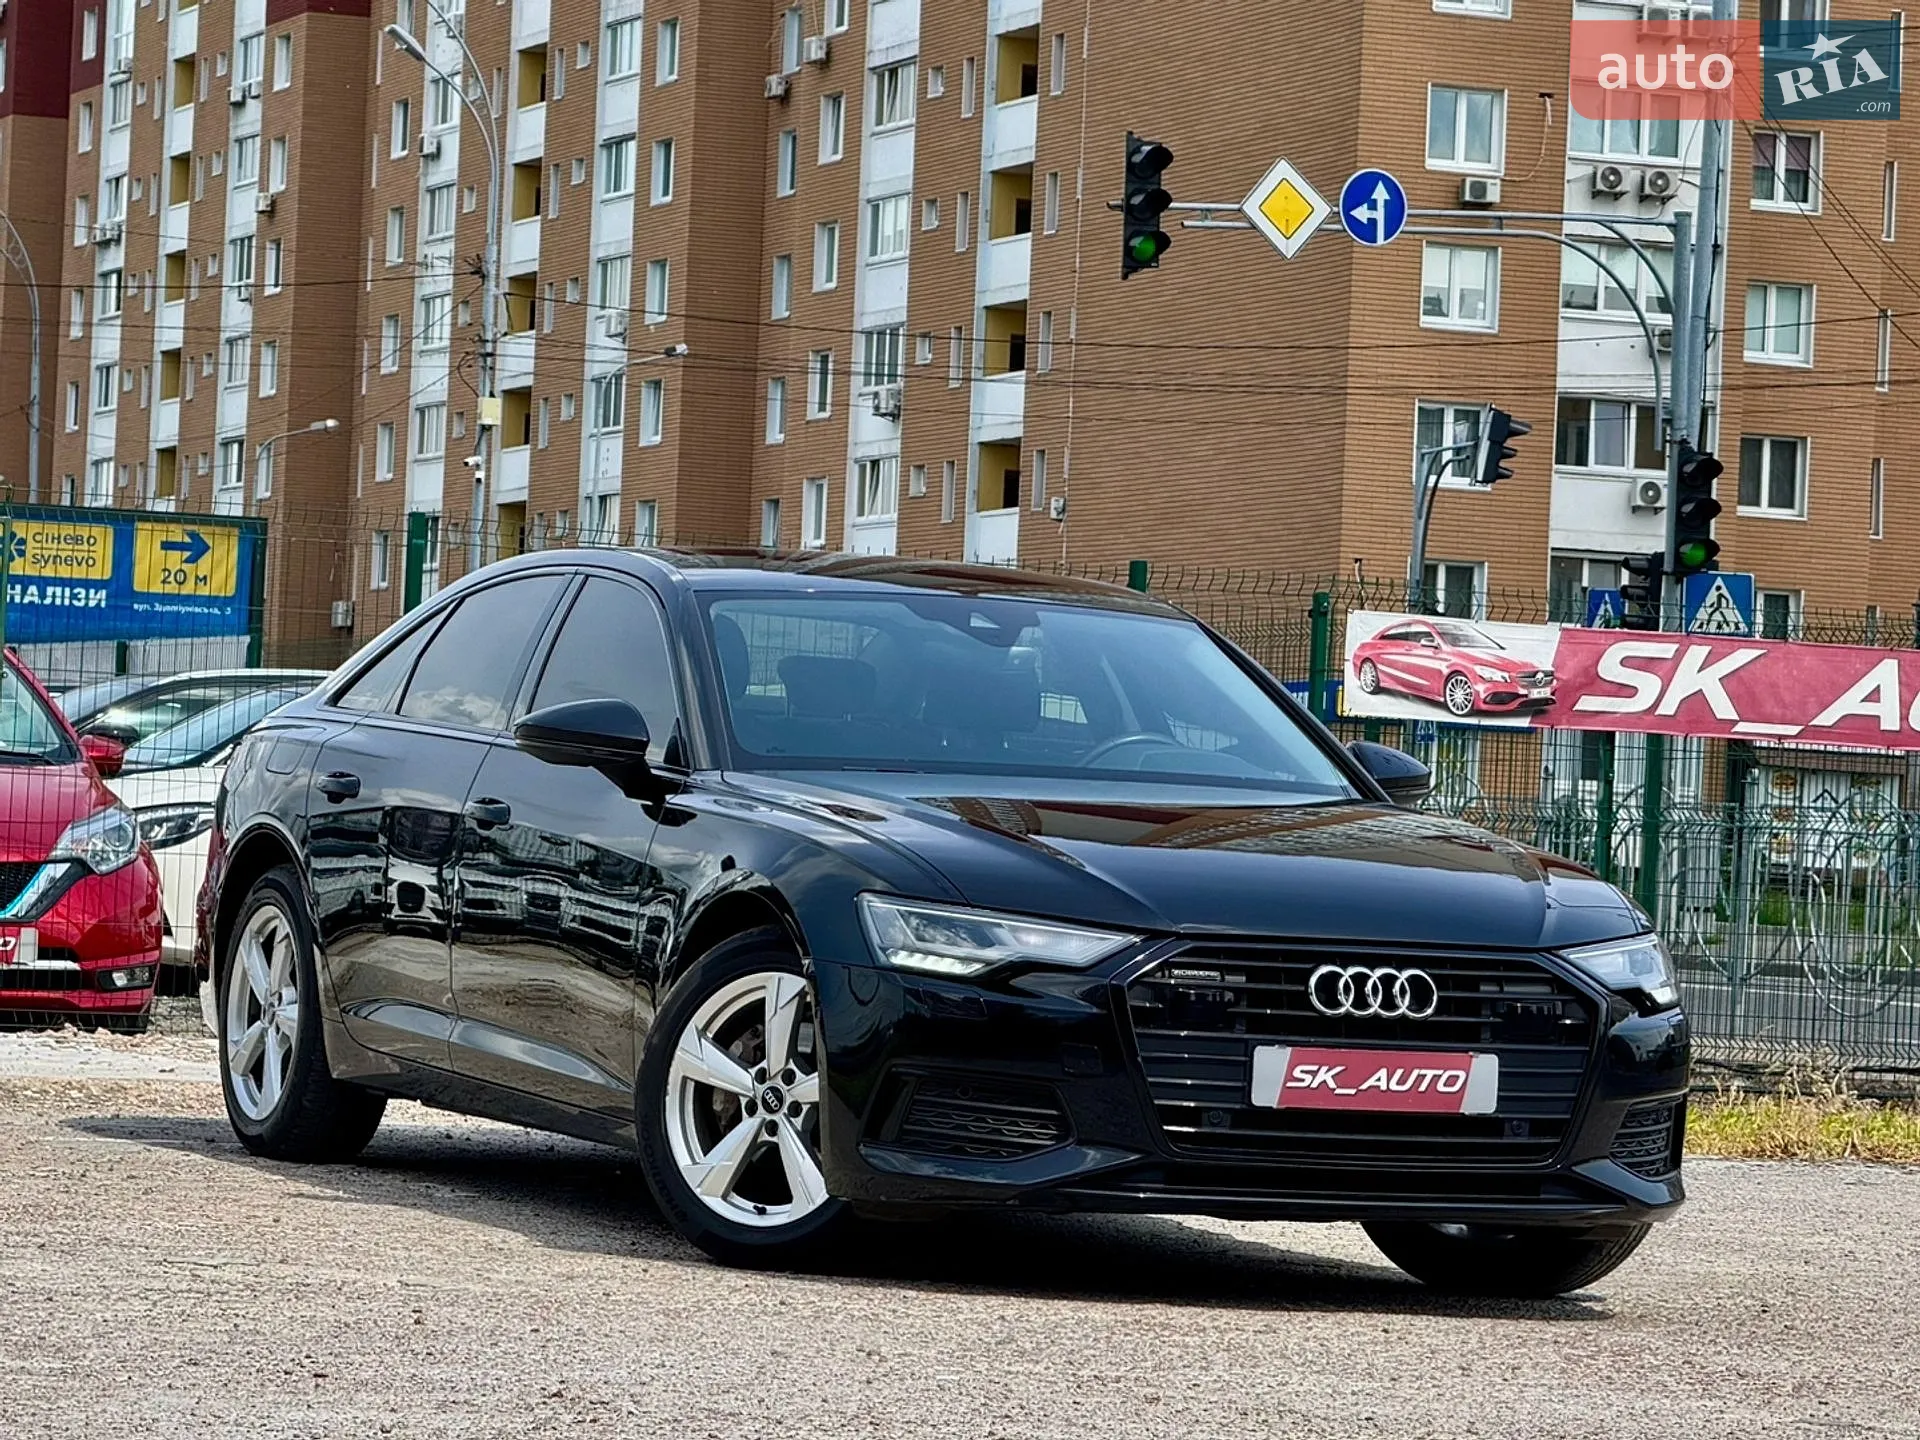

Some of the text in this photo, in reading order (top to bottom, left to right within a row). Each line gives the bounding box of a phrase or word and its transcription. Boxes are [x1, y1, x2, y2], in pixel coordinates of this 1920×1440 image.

[31, 553, 96, 568] synevo
[160, 568, 187, 585] 20
[1286, 1065, 1467, 1095] SK_AUTO
